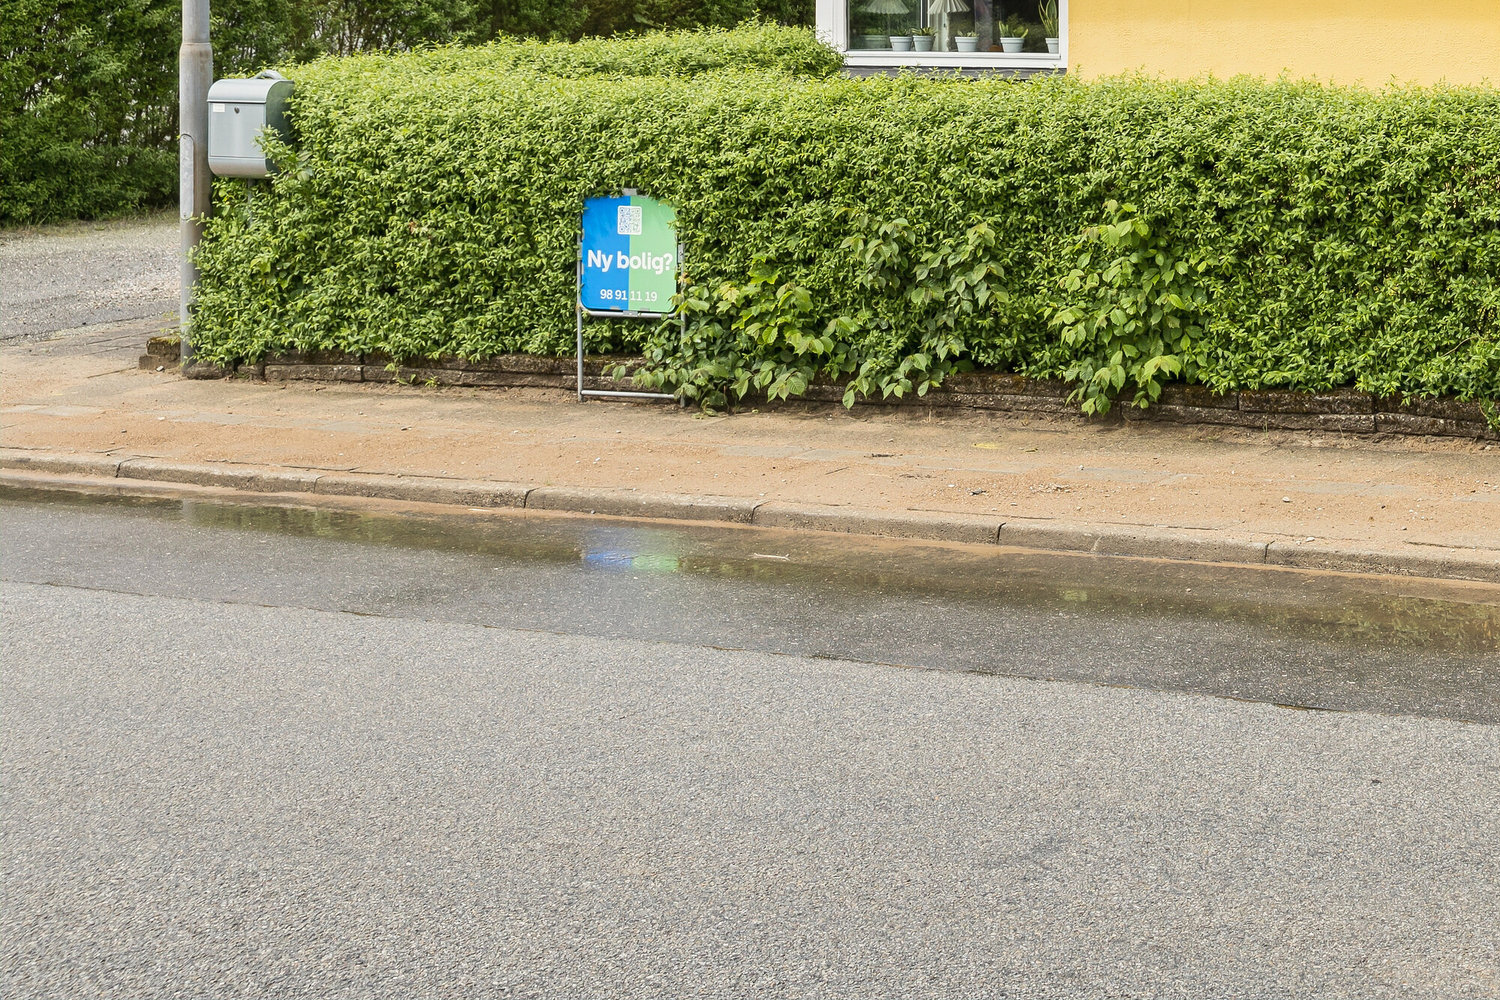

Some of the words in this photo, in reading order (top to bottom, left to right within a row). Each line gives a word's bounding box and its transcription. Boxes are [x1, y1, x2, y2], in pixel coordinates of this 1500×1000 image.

[587, 249, 613, 273] Ny
[616, 250, 674, 275] bolig?
[600, 288, 613, 300] 98
[614, 289, 628, 301] 91
[630, 290, 643, 302] 11
[644, 291, 658, 302] 19
